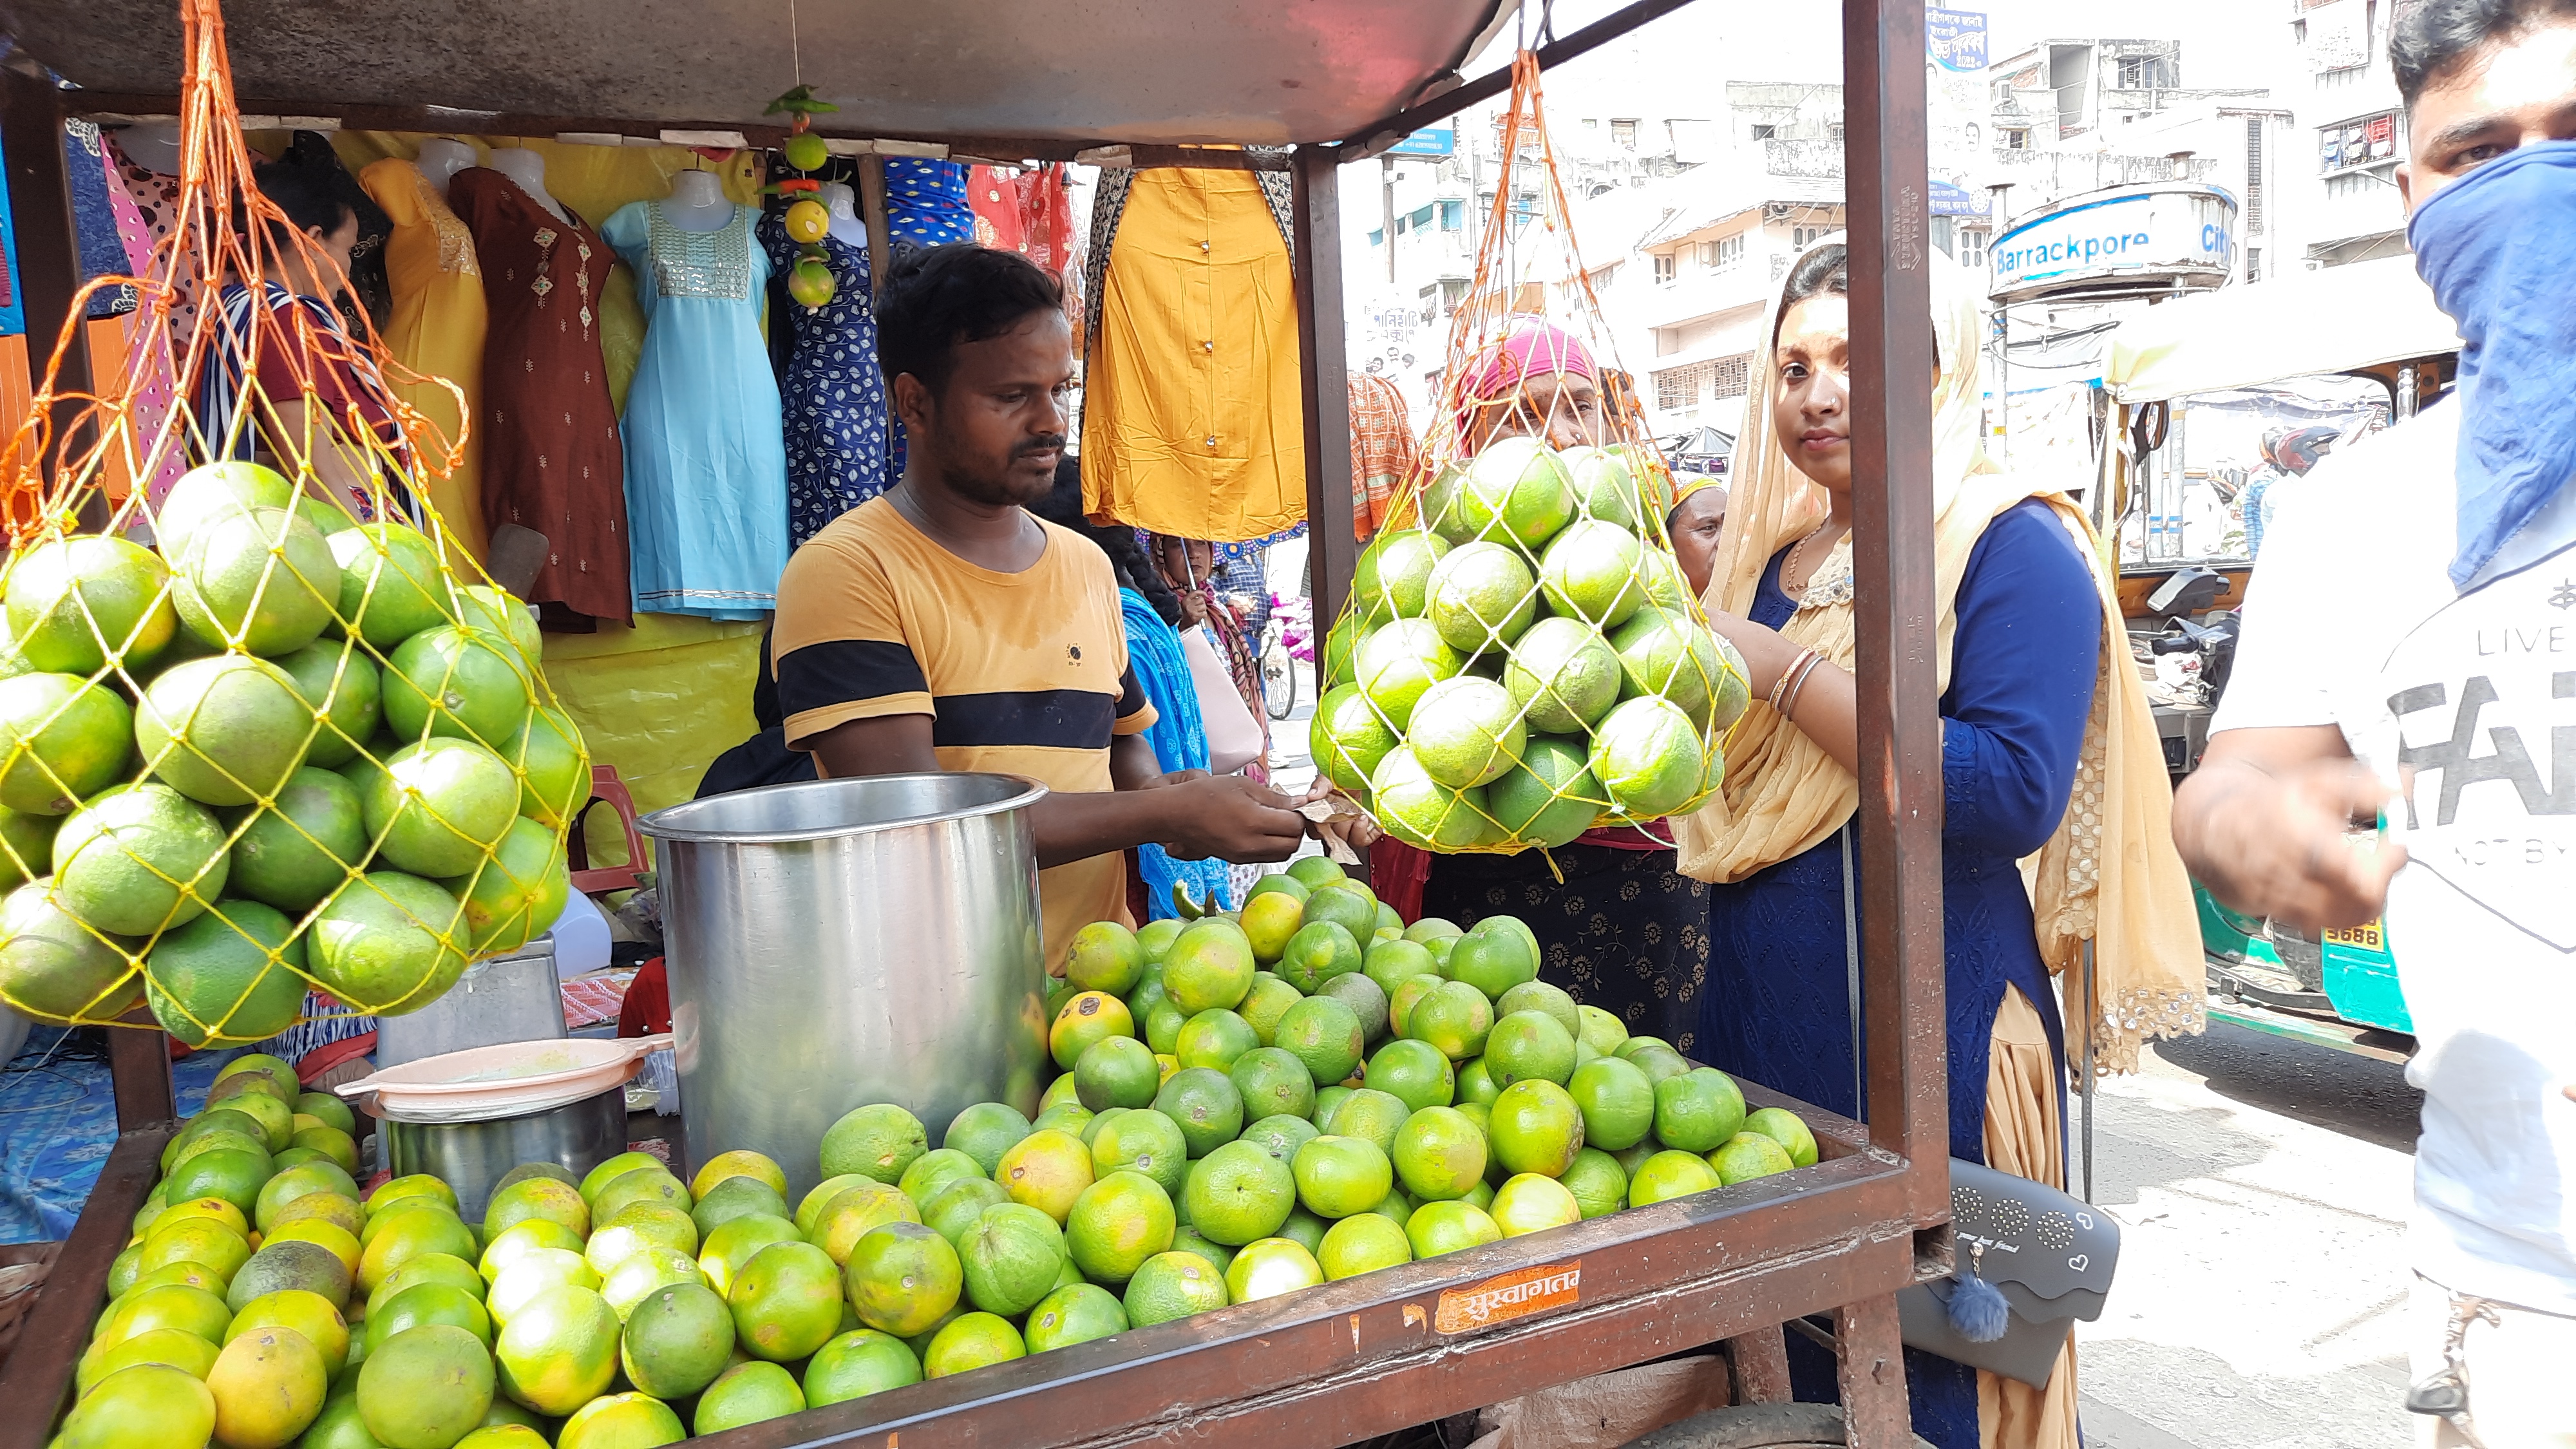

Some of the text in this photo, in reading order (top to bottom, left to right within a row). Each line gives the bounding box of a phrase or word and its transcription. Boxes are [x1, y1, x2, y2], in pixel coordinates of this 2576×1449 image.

[1997, 223, 2230, 275] Barrackpore City
[2477, 626, 2565, 656] LIVE
